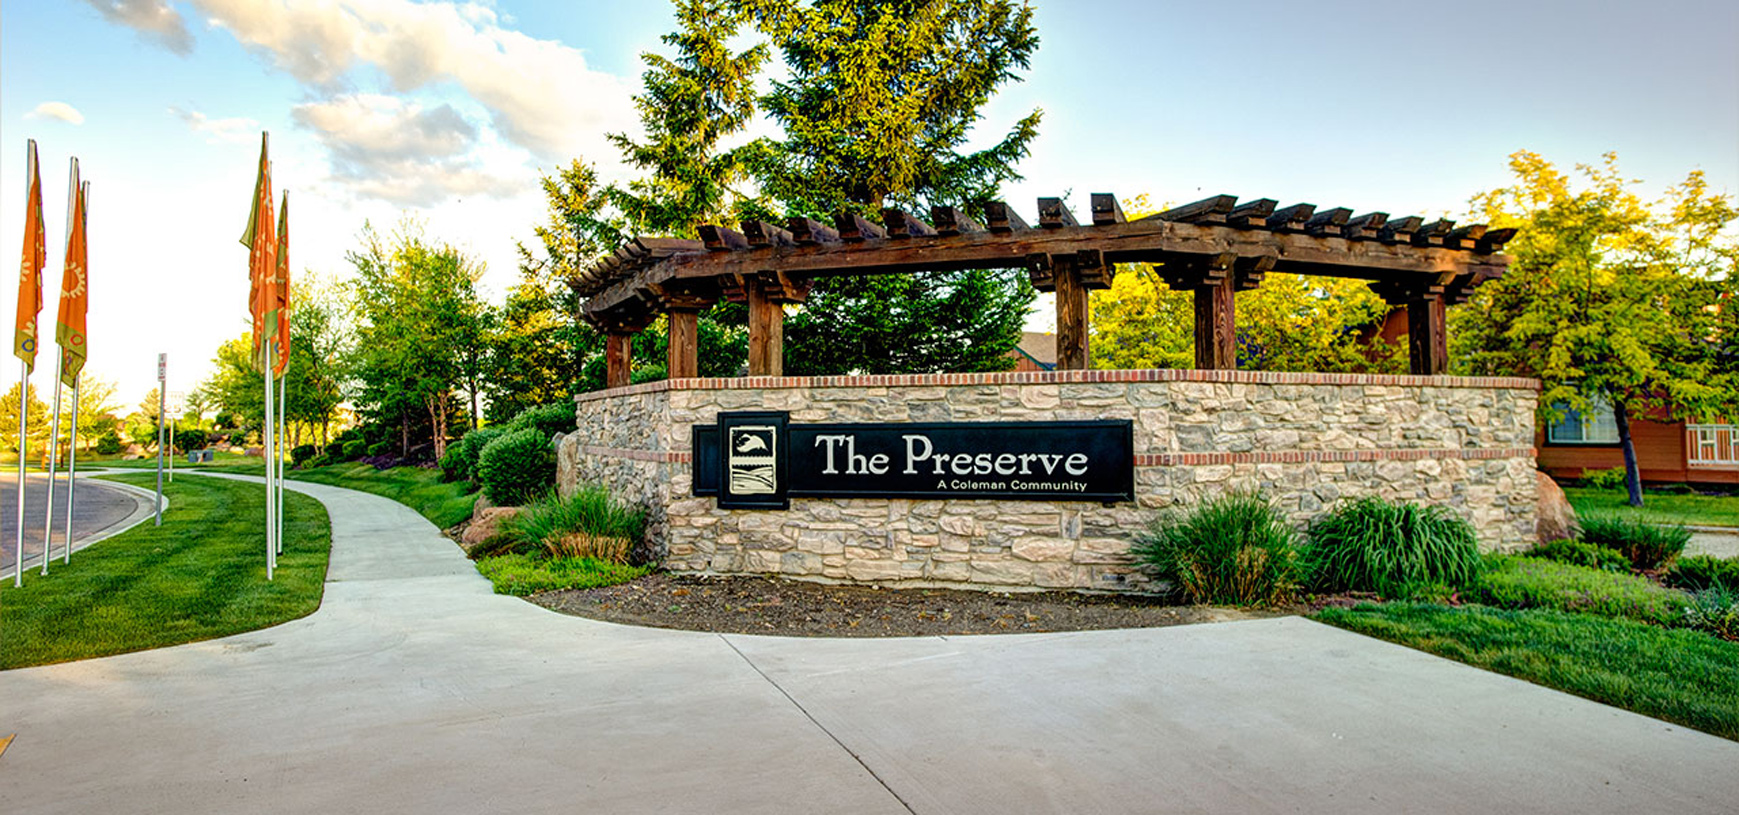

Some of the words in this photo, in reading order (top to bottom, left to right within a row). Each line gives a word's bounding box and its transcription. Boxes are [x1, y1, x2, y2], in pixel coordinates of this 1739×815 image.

[815, 434, 890, 475] The
[902, 434, 1088, 476] Preserve
[937, 479, 948, 490] A
[950, 479, 1006, 491] Coleman
[1010, 479, 1088, 493] Community
